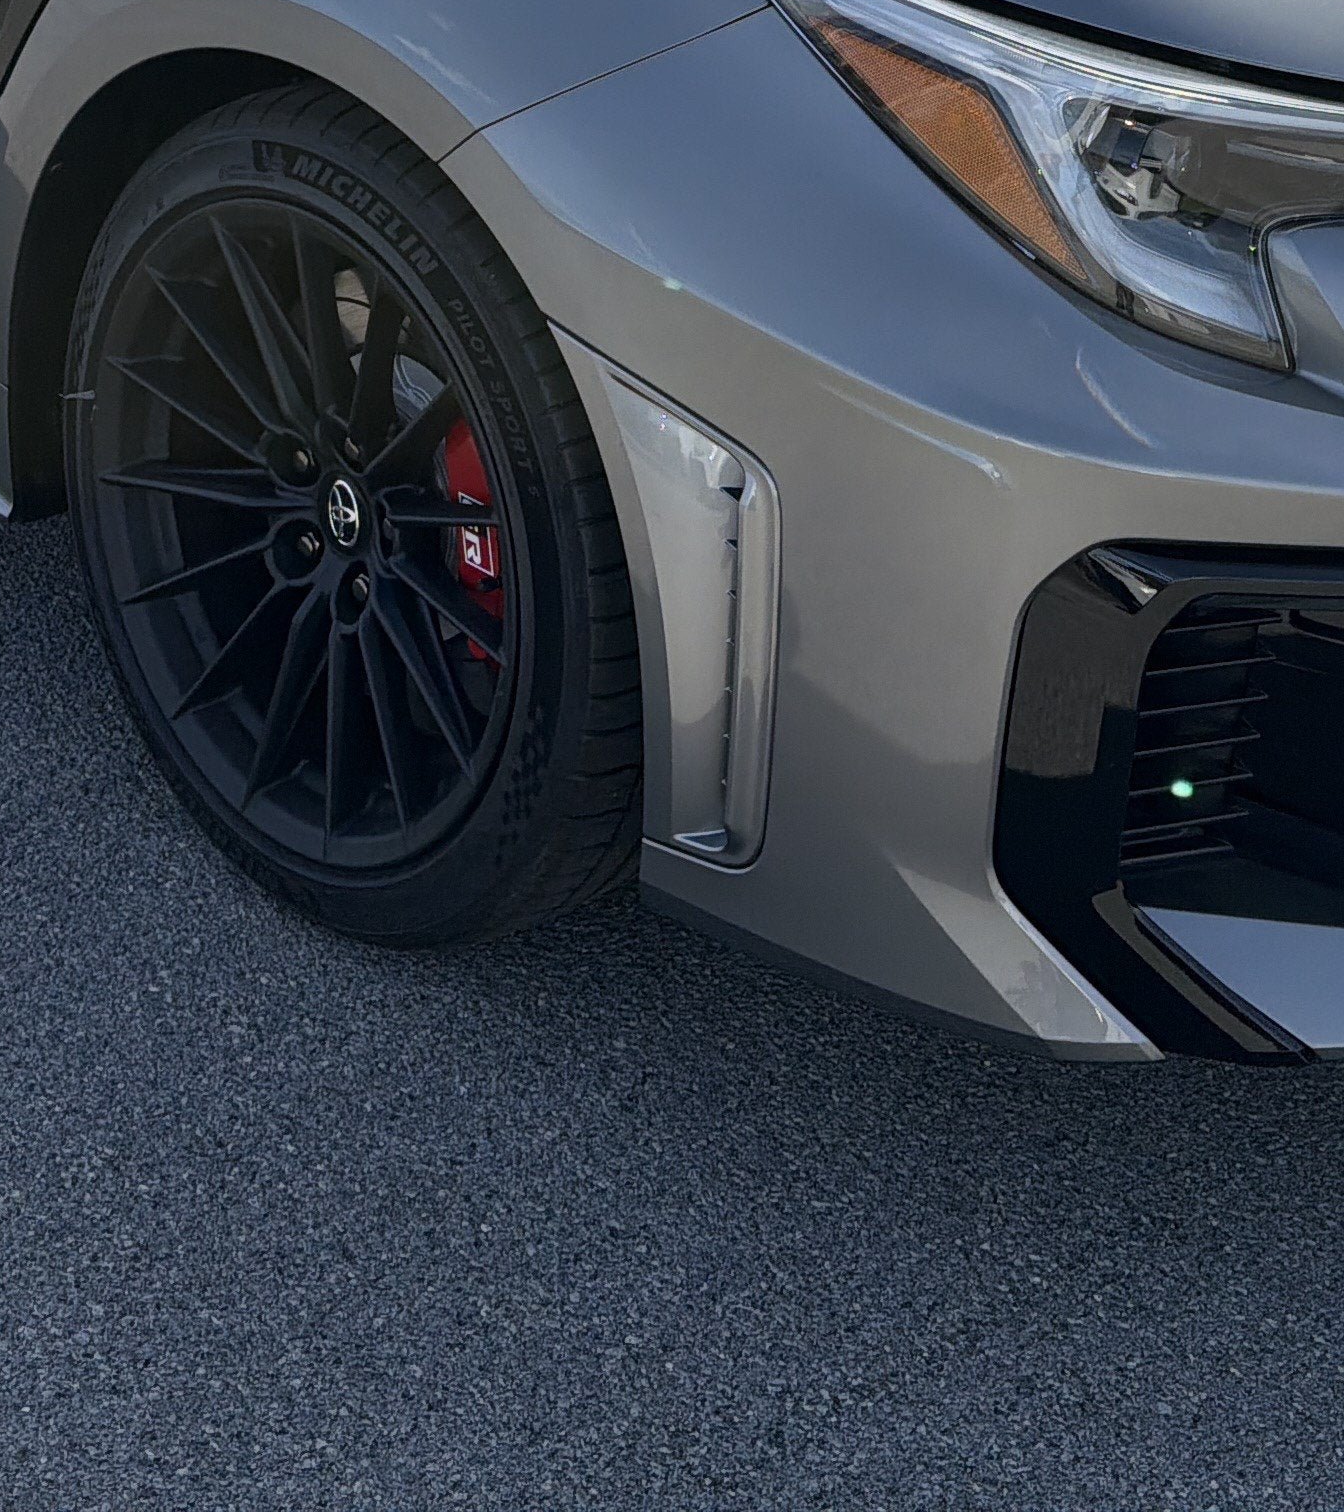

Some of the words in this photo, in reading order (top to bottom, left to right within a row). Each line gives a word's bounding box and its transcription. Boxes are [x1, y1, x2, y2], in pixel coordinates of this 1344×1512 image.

[293, 154, 439, 276] MICHELIN
[448, 298, 495, 369] PILOT
[490, 379, 534, 474] SPORT
